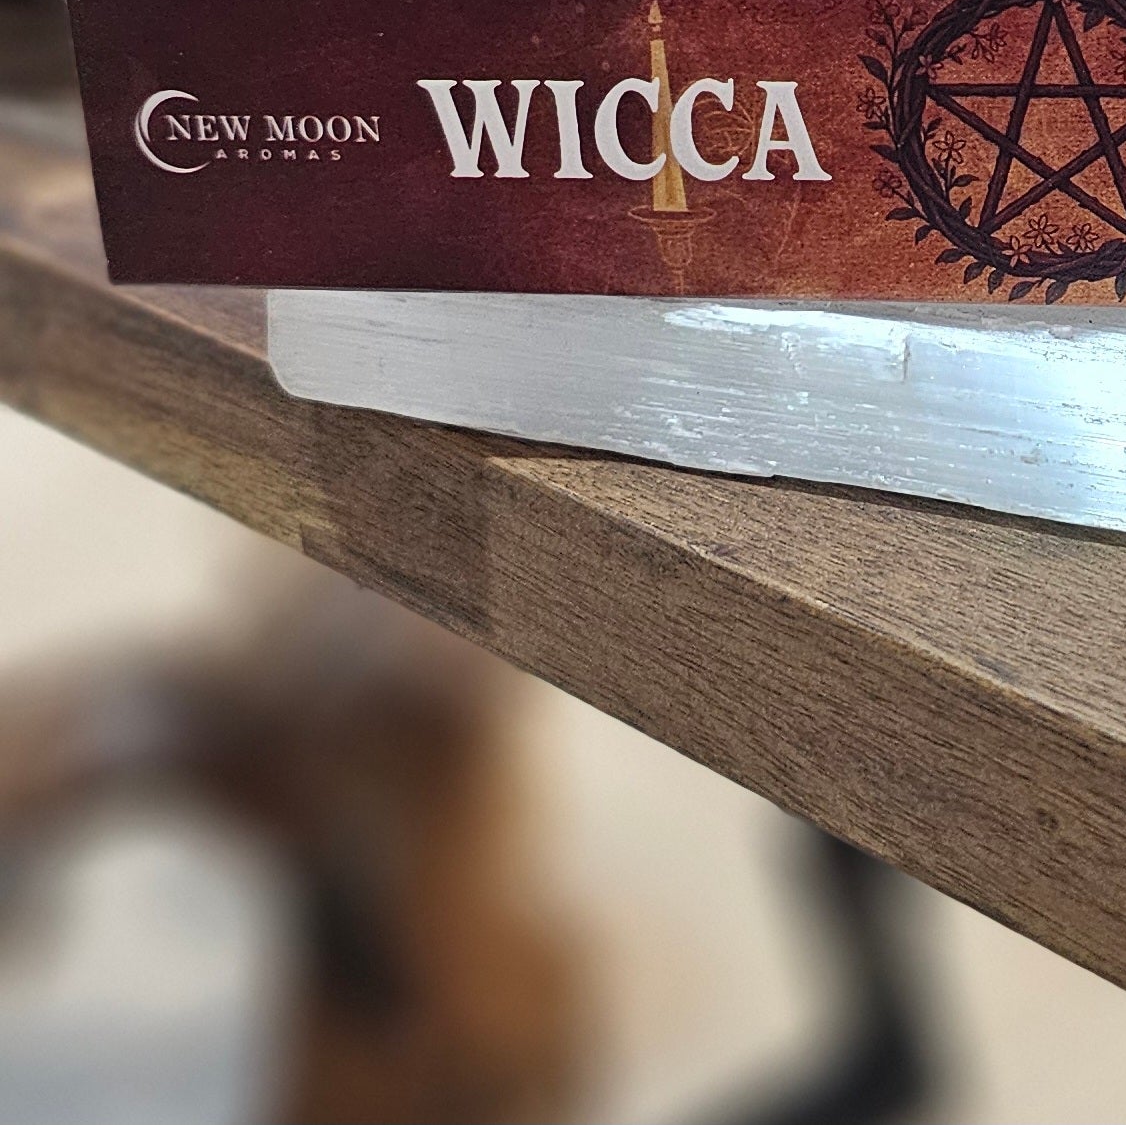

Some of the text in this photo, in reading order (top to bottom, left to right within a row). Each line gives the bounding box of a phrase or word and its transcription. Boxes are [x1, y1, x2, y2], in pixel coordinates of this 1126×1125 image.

[164, 115, 380, 142] NEW MOON
[416, 77, 832, 181] WICCA
[216, 149, 342, 160] AROMAS
